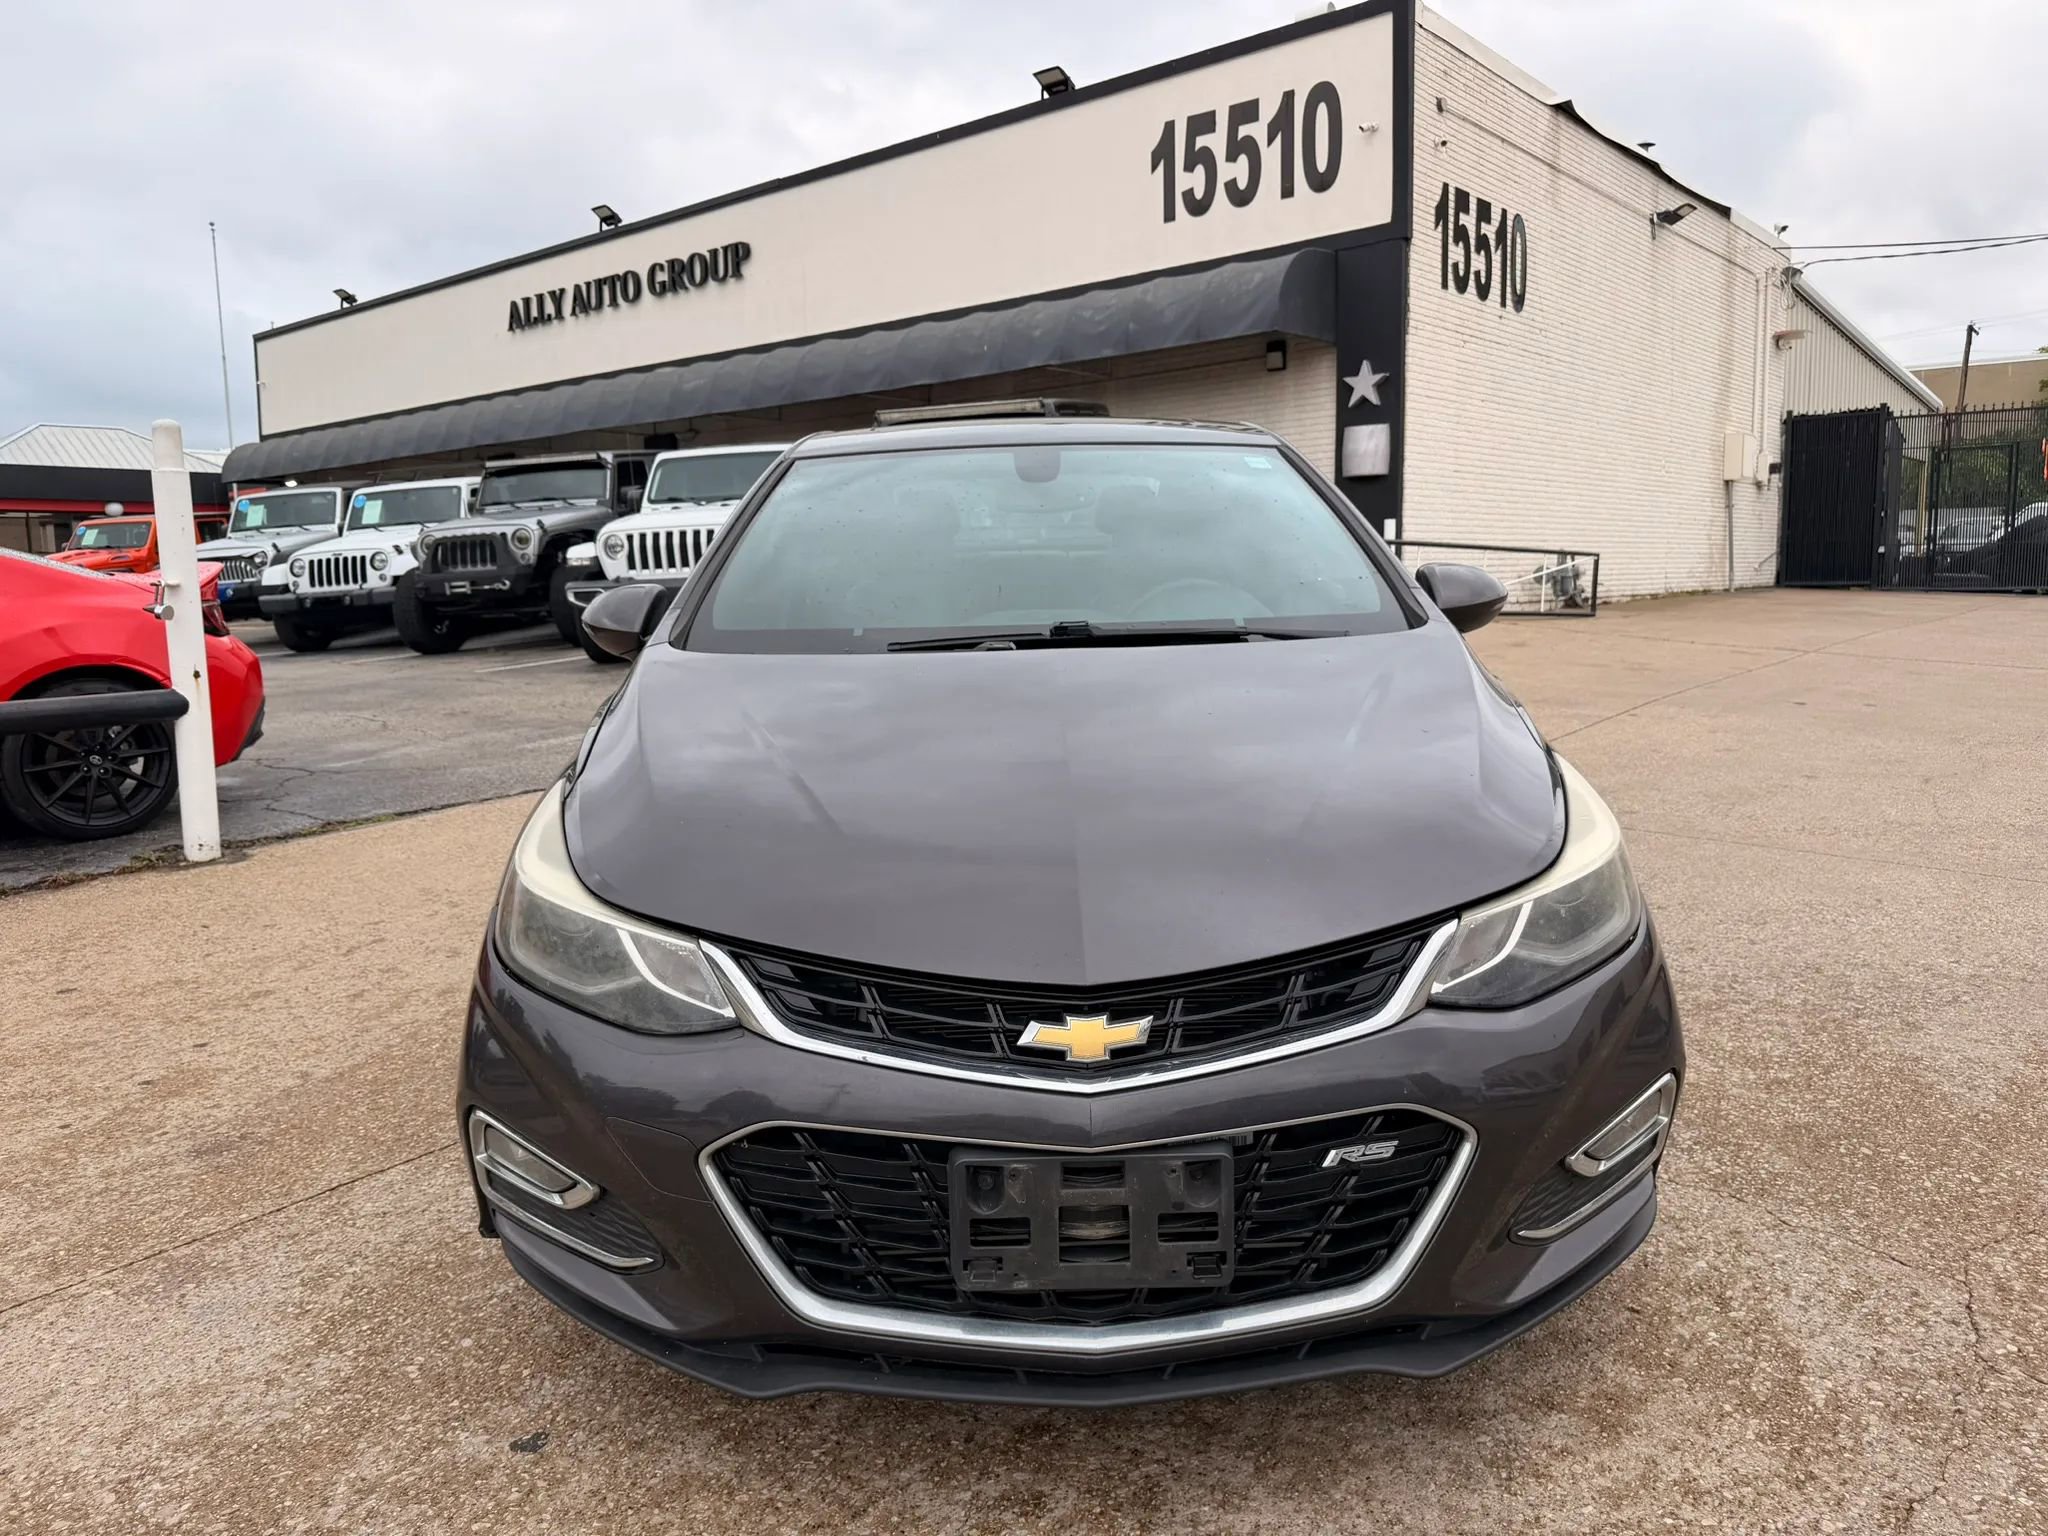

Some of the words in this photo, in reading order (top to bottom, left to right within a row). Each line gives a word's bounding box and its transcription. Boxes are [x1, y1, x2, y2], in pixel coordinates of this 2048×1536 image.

[1150, 80, 1343, 224] 15510
[507, 288, 566, 332] ALLY
[570, 270, 642, 317] AUTO
[647, 241, 752, 297] GROUP
[1433, 181, 1528, 314] 15510
[1321, 1140, 1399, 1168] RS
